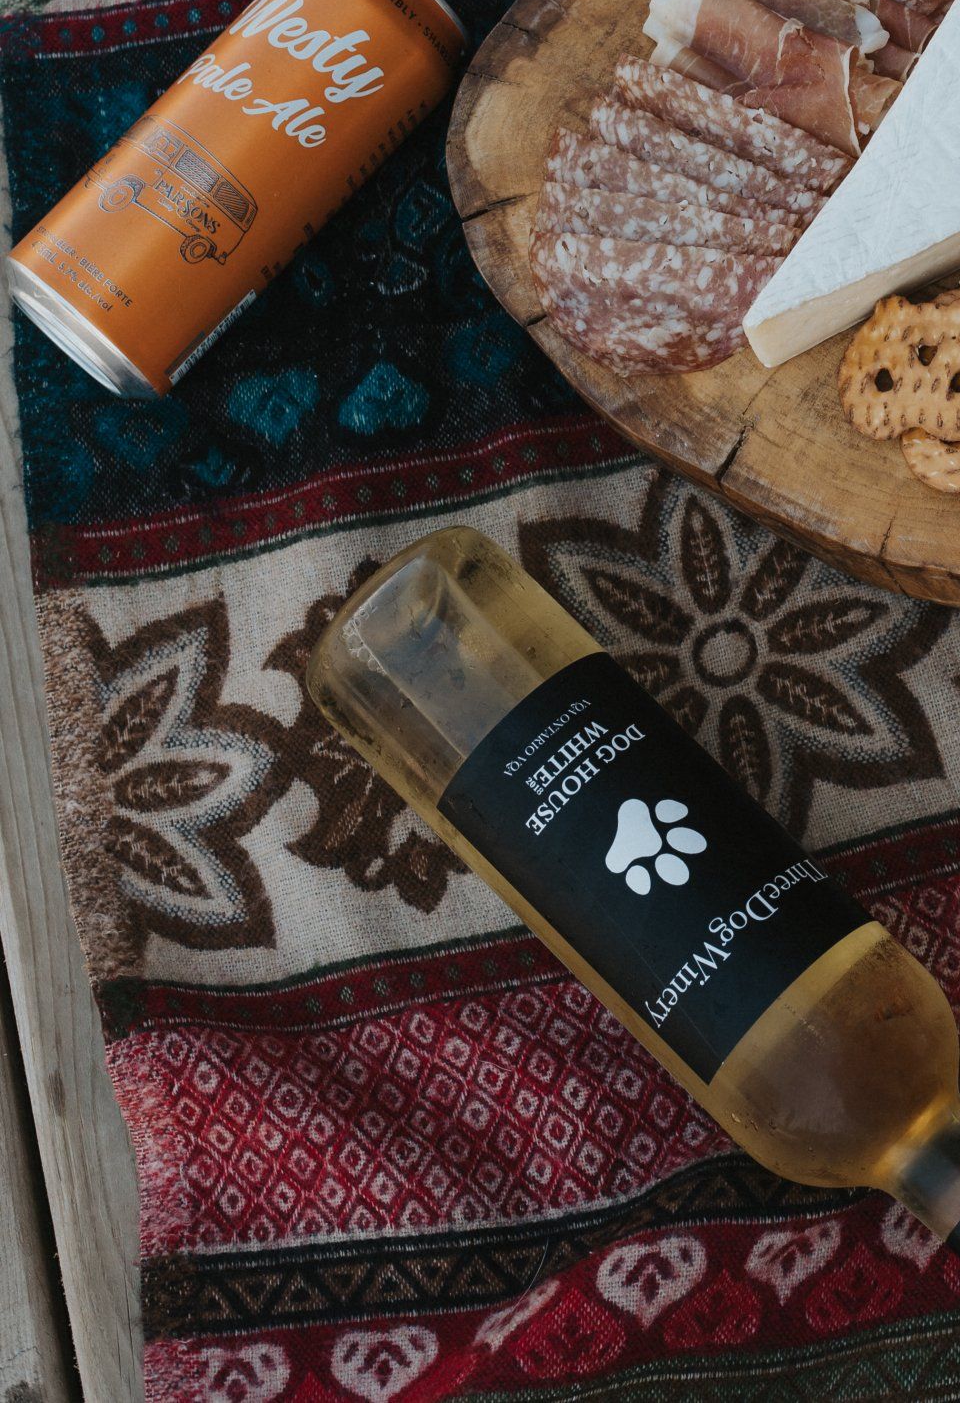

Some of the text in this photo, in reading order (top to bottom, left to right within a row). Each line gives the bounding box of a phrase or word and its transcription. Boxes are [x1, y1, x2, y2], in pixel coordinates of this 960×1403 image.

[178, 53, 254, 101] Pale
[242, 98, 326, 148] Ale
[154, 178, 221, 235] PARSONS
[79, 258, 105, 282] BIÈRE
[103, 279, 133, 308] FORTE
[503, 698, 592, 778] VQA ONTARIO VQA
[532, 720, 609, 789] WHITE
[525, 723, 646, 836] DOG HOUSE
[525, 776, 544, 795] 2018
